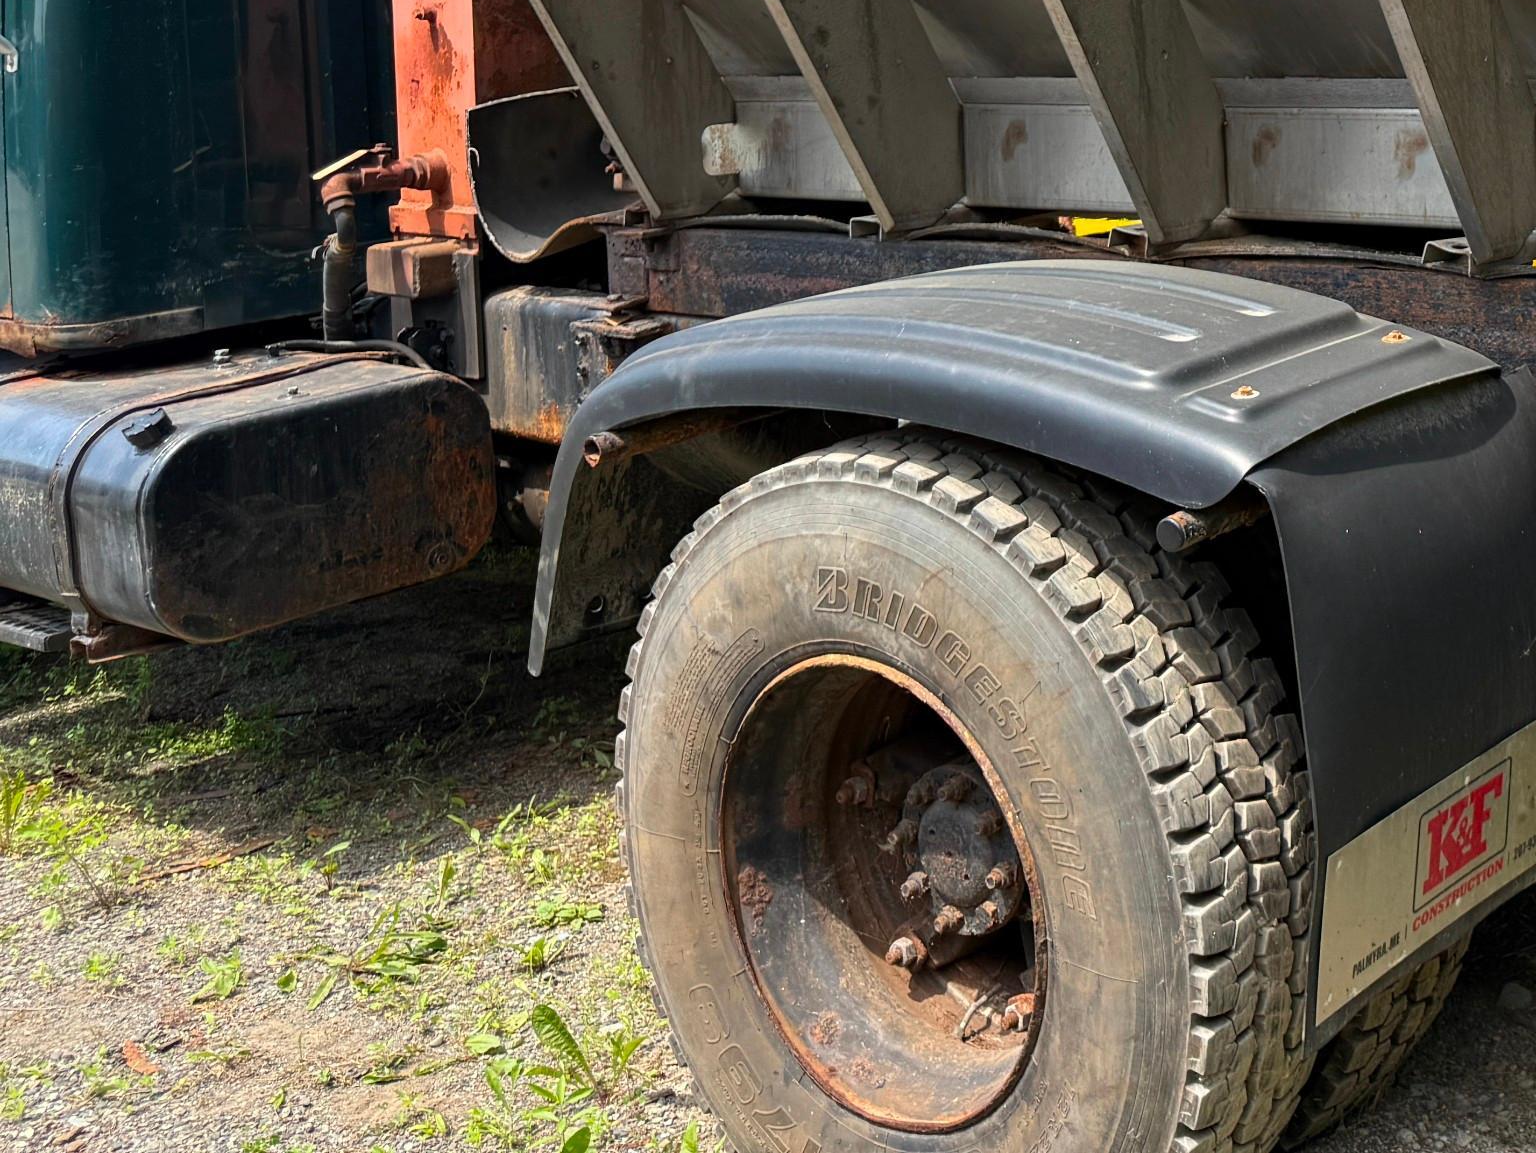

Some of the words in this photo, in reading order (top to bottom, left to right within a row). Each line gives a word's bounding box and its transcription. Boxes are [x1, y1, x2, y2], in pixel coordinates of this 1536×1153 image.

[813, 565, 1098, 921] BRIDGESTONE
[1411, 857, 1505, 933] CONSTRUCTION
[1422, 772, 1505, 897] K&F
